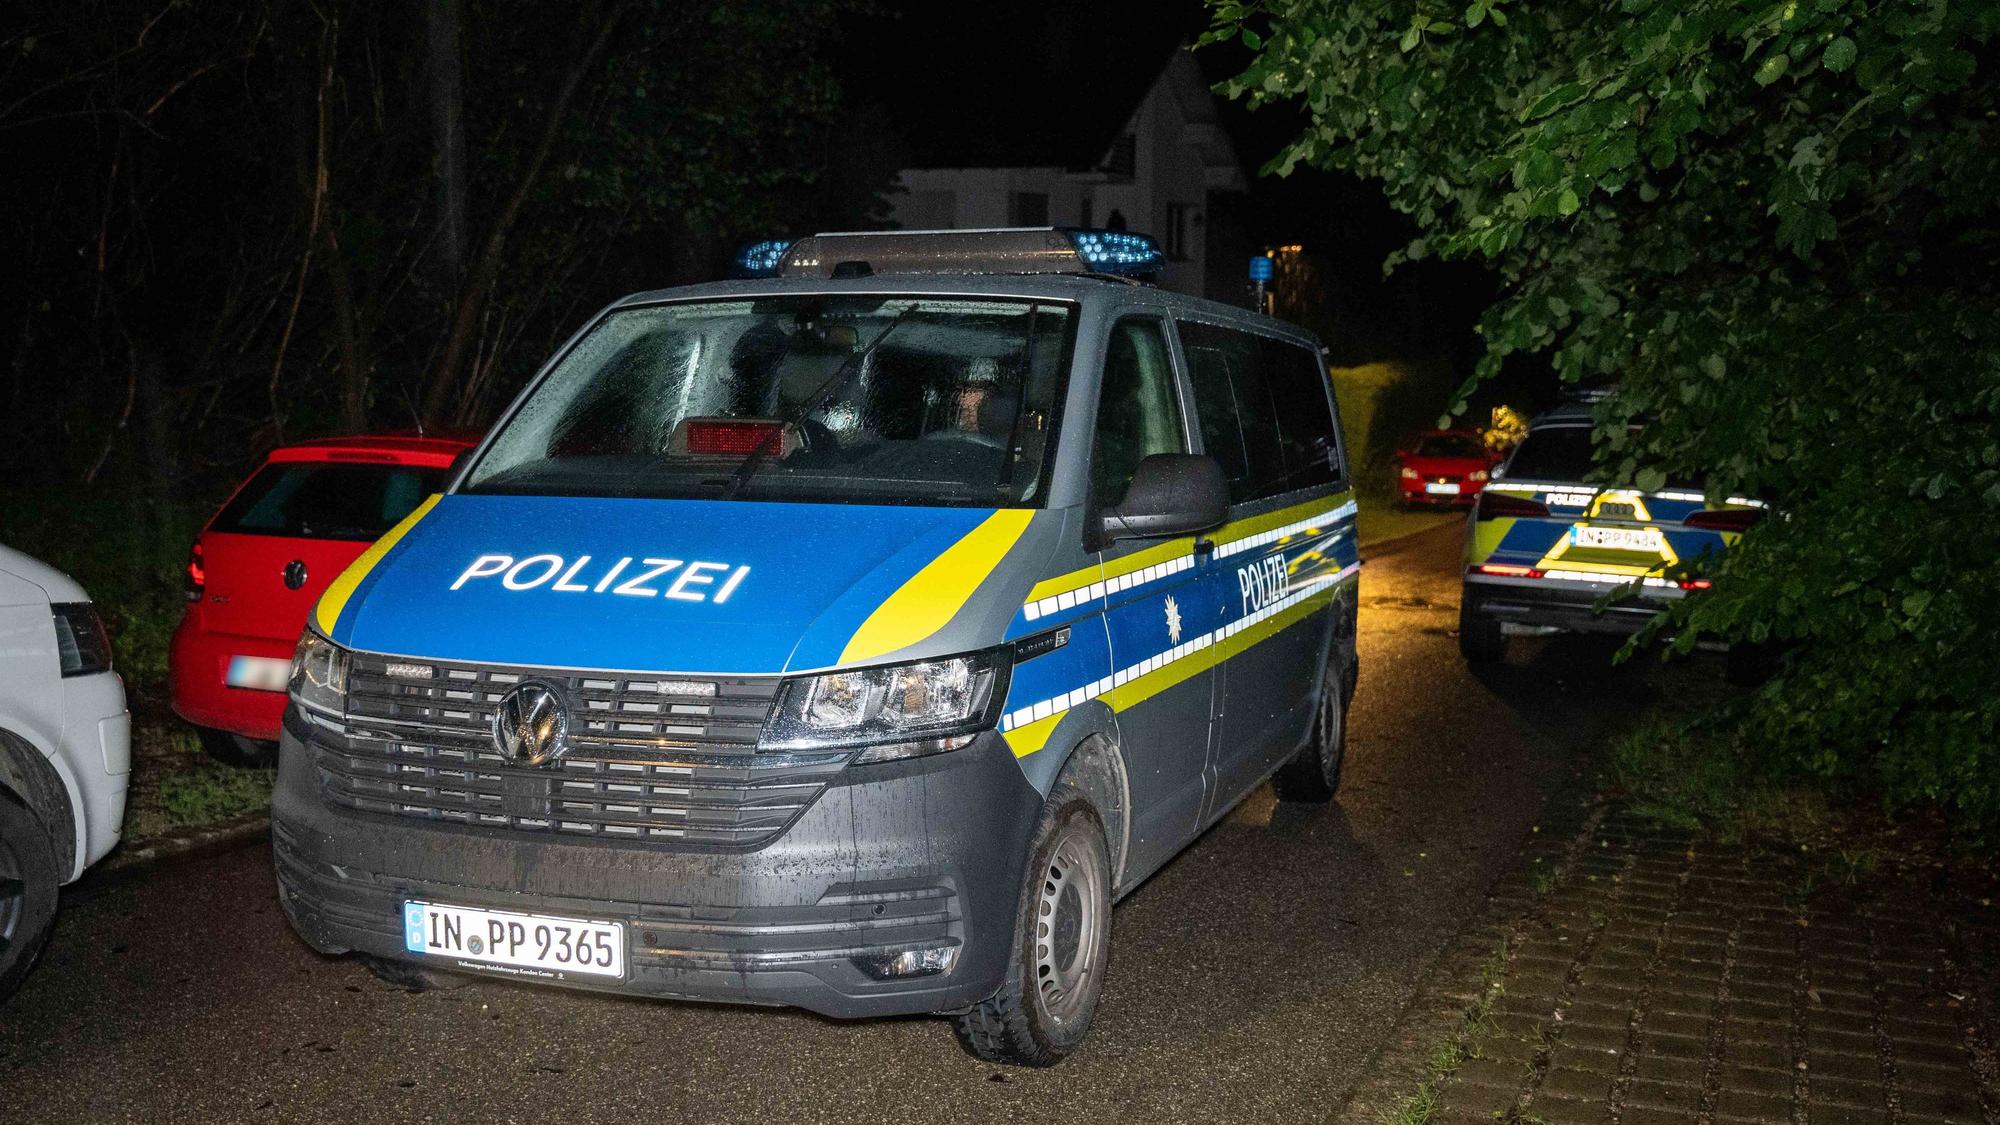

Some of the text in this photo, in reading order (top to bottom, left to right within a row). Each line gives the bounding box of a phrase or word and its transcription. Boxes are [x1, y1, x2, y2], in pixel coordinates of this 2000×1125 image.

[449, 554, 751, 603] POLIZEI
[1238, 553, 1289, 616] POLIZEI
[429, 912, 461, 950] IN
[488, 919, 525, 957] PP
[535, 925, 613, 968] 9365
